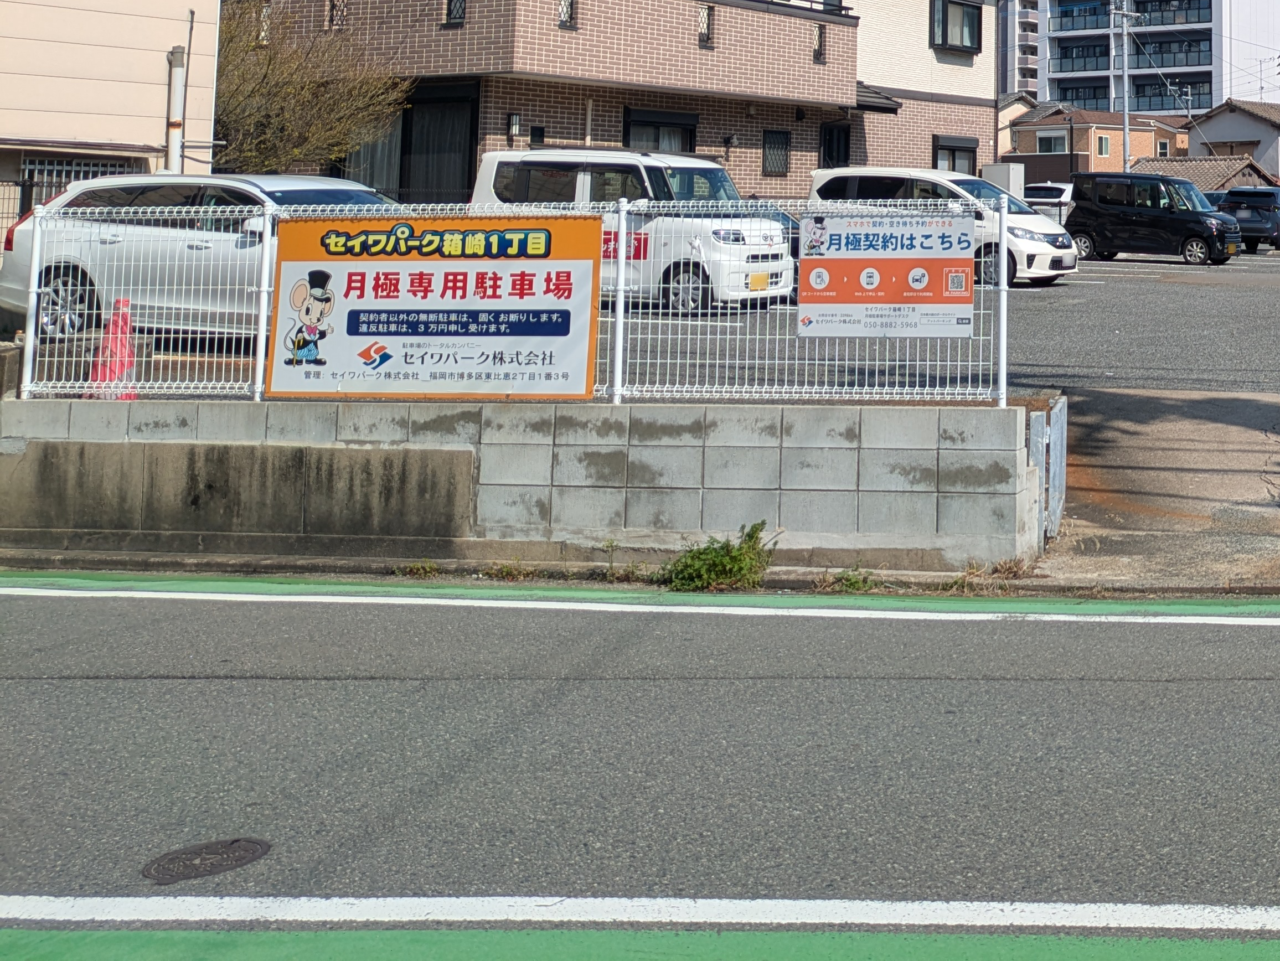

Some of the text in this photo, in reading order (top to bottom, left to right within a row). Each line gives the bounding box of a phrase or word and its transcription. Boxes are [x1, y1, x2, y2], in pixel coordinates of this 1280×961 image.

[826, 232, 972, 252] 月極契約はこちら
[343, 270, 574, 301] 月極専用駐車場
[863, 321, 918, 329] 050-8882-5968
[401, 350, 556, 367] セイワパーク株式会社
